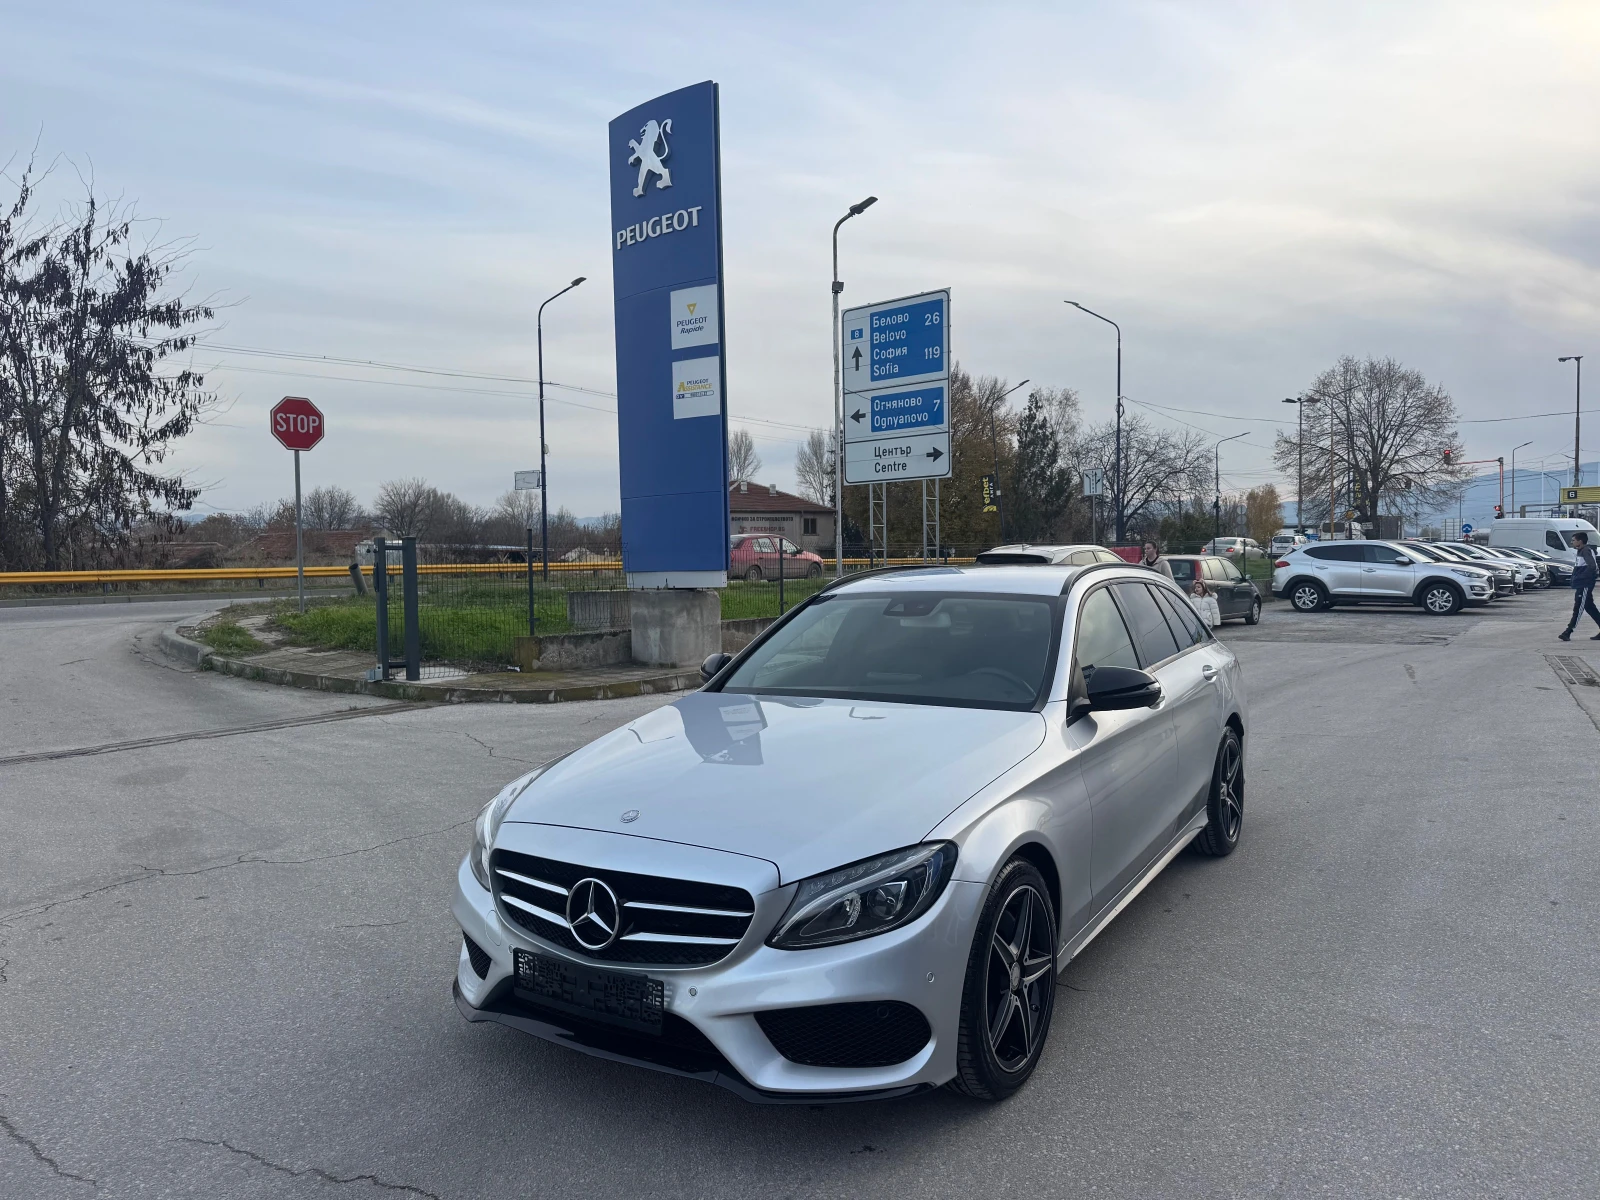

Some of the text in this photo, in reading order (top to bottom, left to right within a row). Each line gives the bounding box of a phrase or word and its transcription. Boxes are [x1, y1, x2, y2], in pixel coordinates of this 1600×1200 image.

[616, 206, 702, 250] PEUGEOT
[677, 316, 707, 327] PEUGEOT
[873, 312, 940, 328] Белово 26
[680, 325, 704, 335] Rapide
[854, 330, 860, 338] 8
[873, 330, 907, 344] Belovo
[873, 346, 940, 360] София 119
[873, 363, 899, 376] Sofia
[686, 378, 709, 386] PEUGEOT
[873, 396, 941, 412] Огняново 7
[276, 412, 320, 434] STOP
[874, 412, 929, 429] Ognyanovo
[874, 445, 912, 459] Център
[874, 461, 907, 473] Centre
[982, 476, 991, 504] efbet
